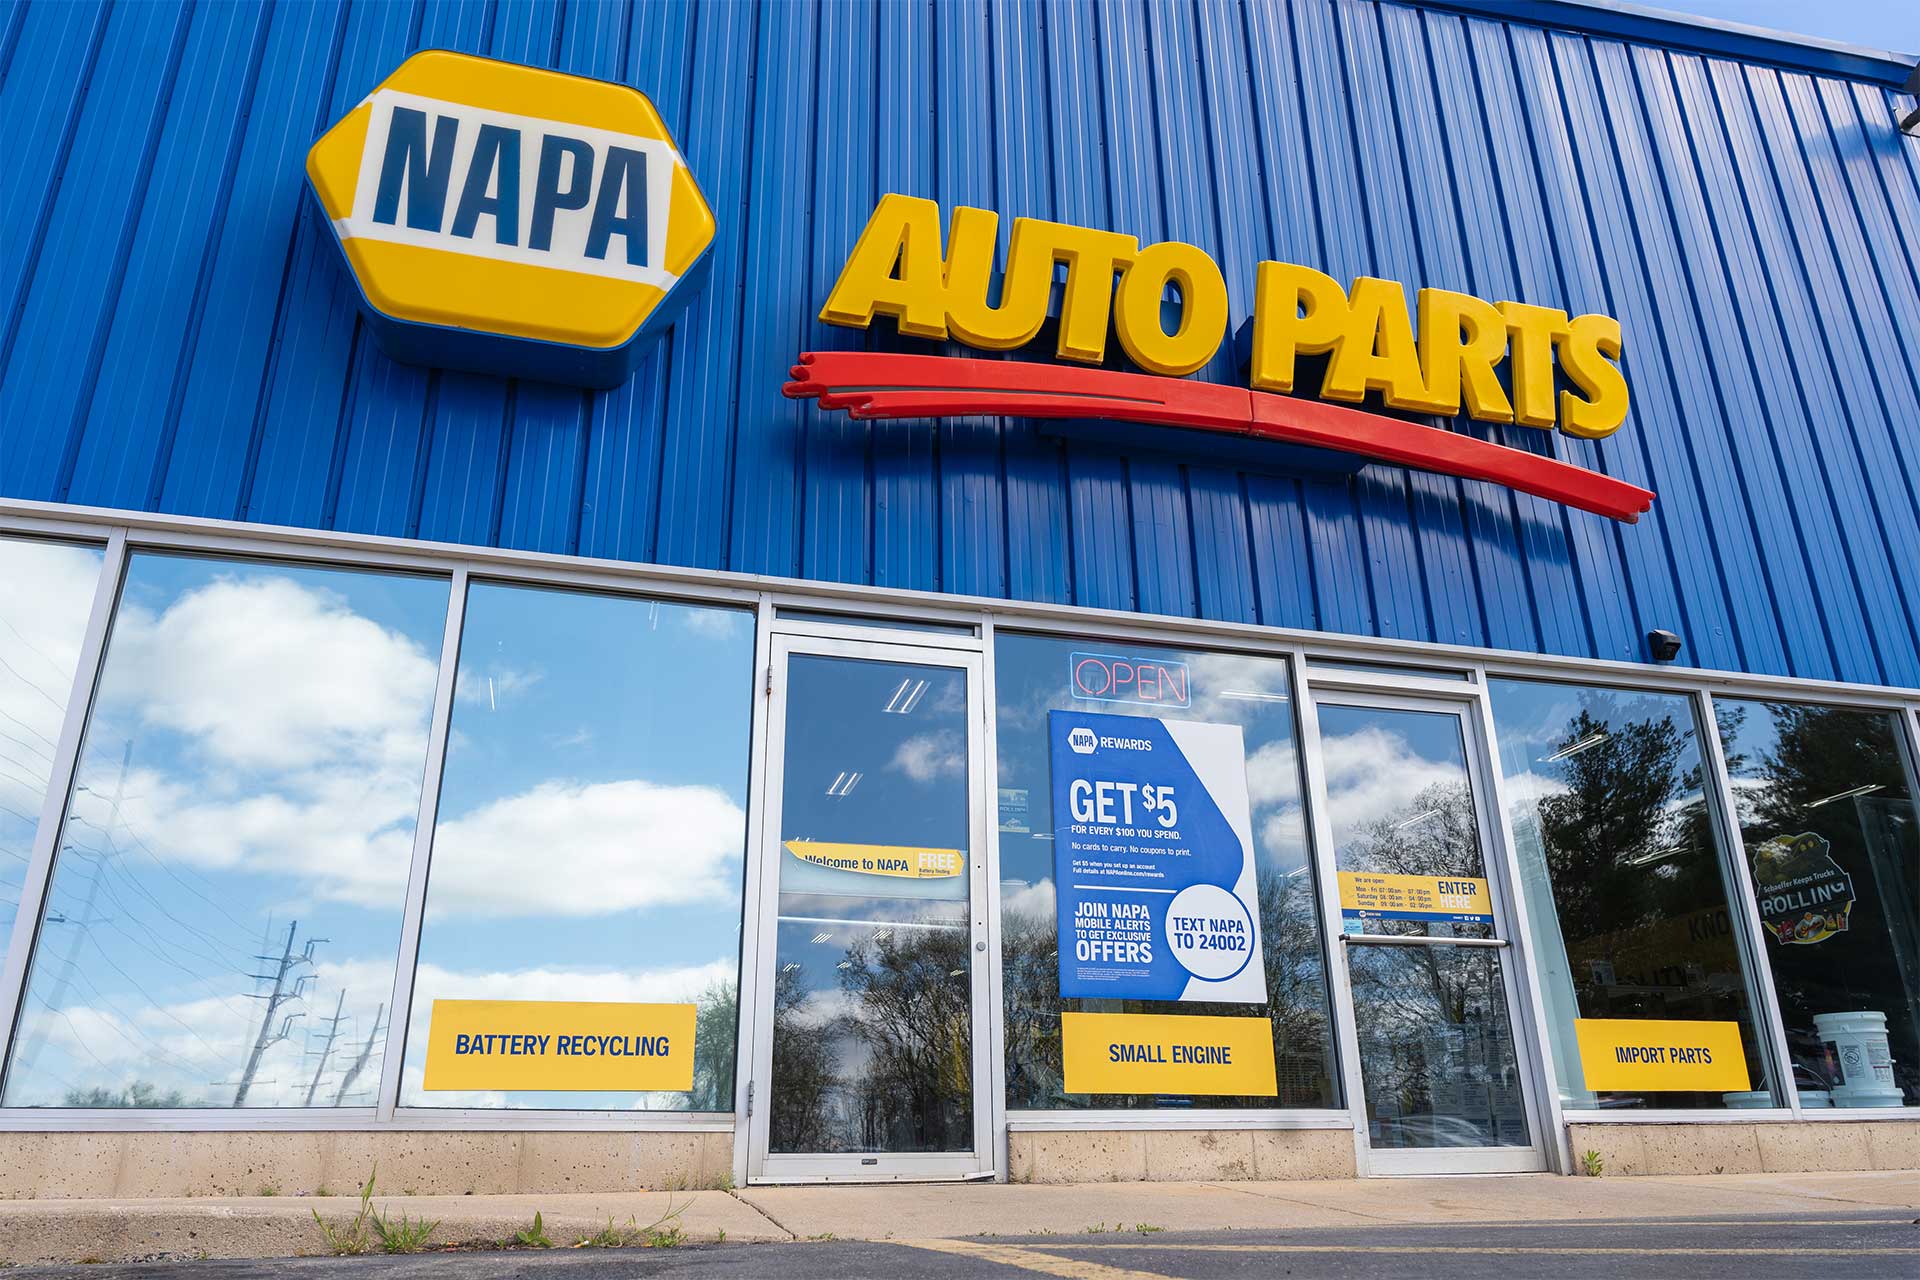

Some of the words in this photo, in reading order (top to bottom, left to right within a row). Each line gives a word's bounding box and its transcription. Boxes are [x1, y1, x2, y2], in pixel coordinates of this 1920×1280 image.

[373, 106, 648, 268] NAPA
[818, 192, 1228, 376] AUTO
[1250, 260, 1629, 439] PARTS
[1075, 659, 1186, 701] OPEN
[1072, 734, 1094, 748] NAPA
[1100, 736, 1152, 751] REWARDS
[1069, 779, 1137, 825] GET
[1142, 783, 1178, 828] $5
[1071, 825, 1086, 834] FOR
[1089, 826, 1113, 836] EVERY
[1116, 827, 1135, 837] $100
[1137, 829, 1152, 838] YOU
[1154, 830, 1181, 840] SPEND.
[1072, 842, 1081, 850] No
[1083, 843, 1100, 851] cards
[1110, 845, 1128, 854] carry.
[1130, 845, 1139, 853] No
[1140, 847, 1166, 856] coupons
[1168, 848, 1174, 856] to
[1176, 848, 1191, 857] print.
[805, 855, 858, 869] Welcome
[862, 858, 874, 870] to
[877, 859, 909, 872] NAPA
[918, 852, 955, 868] FREE
[1438, 881, 1477, 896] ENTER
[1763, 880, 1793, 893] Schaeffer
[1793, 875, 1813, 887] Keeps
[1813, 869, 1835, 880] Trucks
[1440, 895, 1472, 909] HERE
[1761, 882, 1846, 916] ROLLING
[1075, 902, 1108, 918] JOIN
[1112, 903, 1150, 919] NAPA
[1075, 918, 1111, 930] MOBILE
[1114, 919, 1151, 931] ALERTS
[1173, 917, 1205, 932] TEXT
[1209, 919, 1245, 933] NAPA
[1075, 930, 1086, 939] TO
[1089, 930, 1104, 939] GET
[1107, 931, 1151, 942] EXCLUSIVE
[1174, 933, 1194, 949] TO
[1199, 933, 1246, 951] 24002
[1076, 940, 1153, 963] OFFERS
[455, 1034, 550, 1055] BATTERY
[557, 1035, 670, 1057] RECYCLING
[1109, 1044, 1167, 1063] SMALL
[1173, 1046, 1232, 1064] ENGINE
[1615, 1046, 1665, 1064] IMPORT
[1670, 1047, 1712, 1065] PARTS
